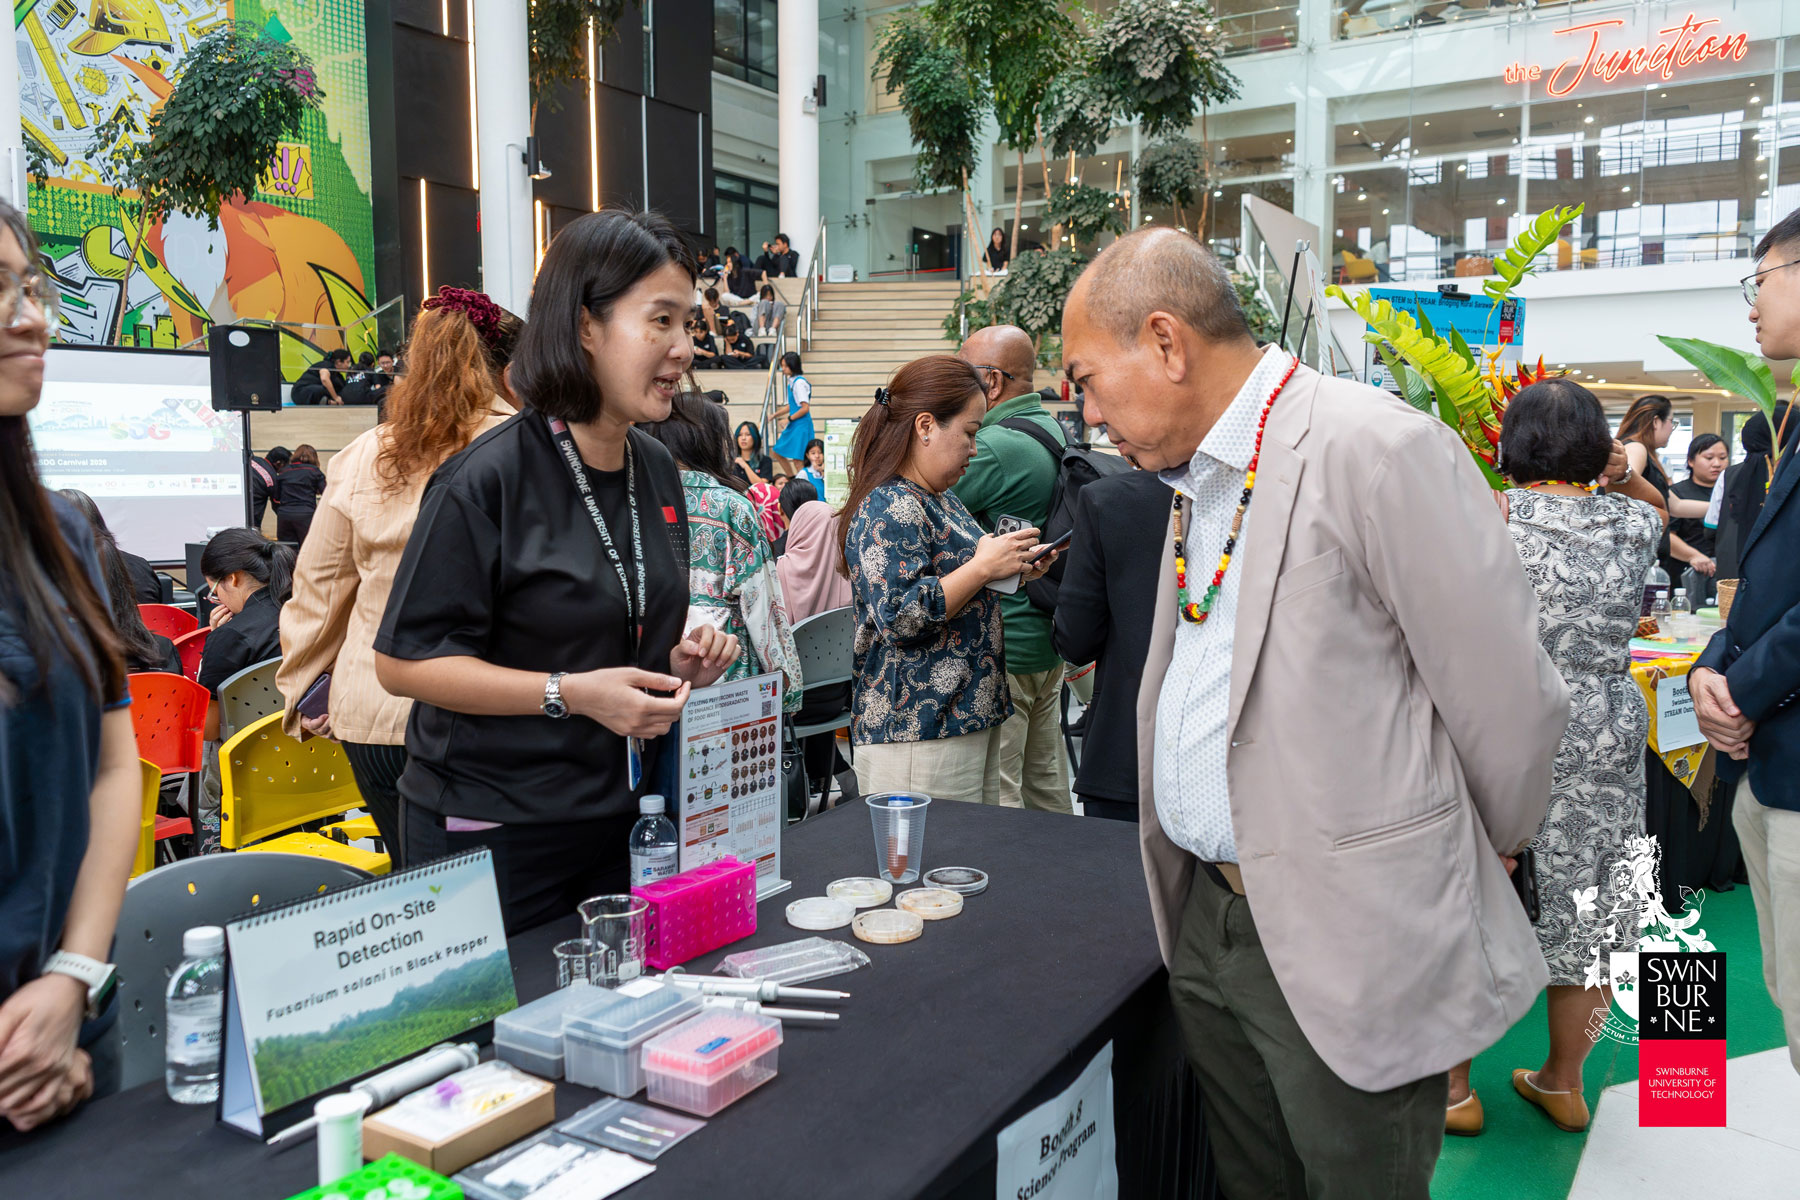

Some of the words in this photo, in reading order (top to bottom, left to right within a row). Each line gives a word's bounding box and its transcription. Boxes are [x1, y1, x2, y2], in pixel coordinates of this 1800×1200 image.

[1504, 63, 1542, 83] the
[1546, 12, 1749, 97] Junction
[1392, 295, 1407, 303] STEM
[109, 423, 171, 440] SDG
[57, 458, 88, 466] Carnival
[629, 494, 636, 506] OF
[584, 495, 613, 546] UNIVERSITY
[608, 548, 620, 560] OF
[631, 507, 643, 559] UNIVERSITY
[695, 704, 713, 713] ENHANCE
[1664, 707, 1682, 718] STREAM
[314, 919, 366, 949] Rapid
[370, 899, 436, 930] On-Site
[337, 928, 424, 969] Detection
[266, 987, 339, 1021] Fusarium
[343, 968, 386, 994] solani
[390, 965, 402, 978] in
[407, 950, 442, 971] Black
[446, 934, 489, 957] Pepper
[1017, 1162, 1057, 1200] Science
[1058, 1120, 1096, 1168] Program
